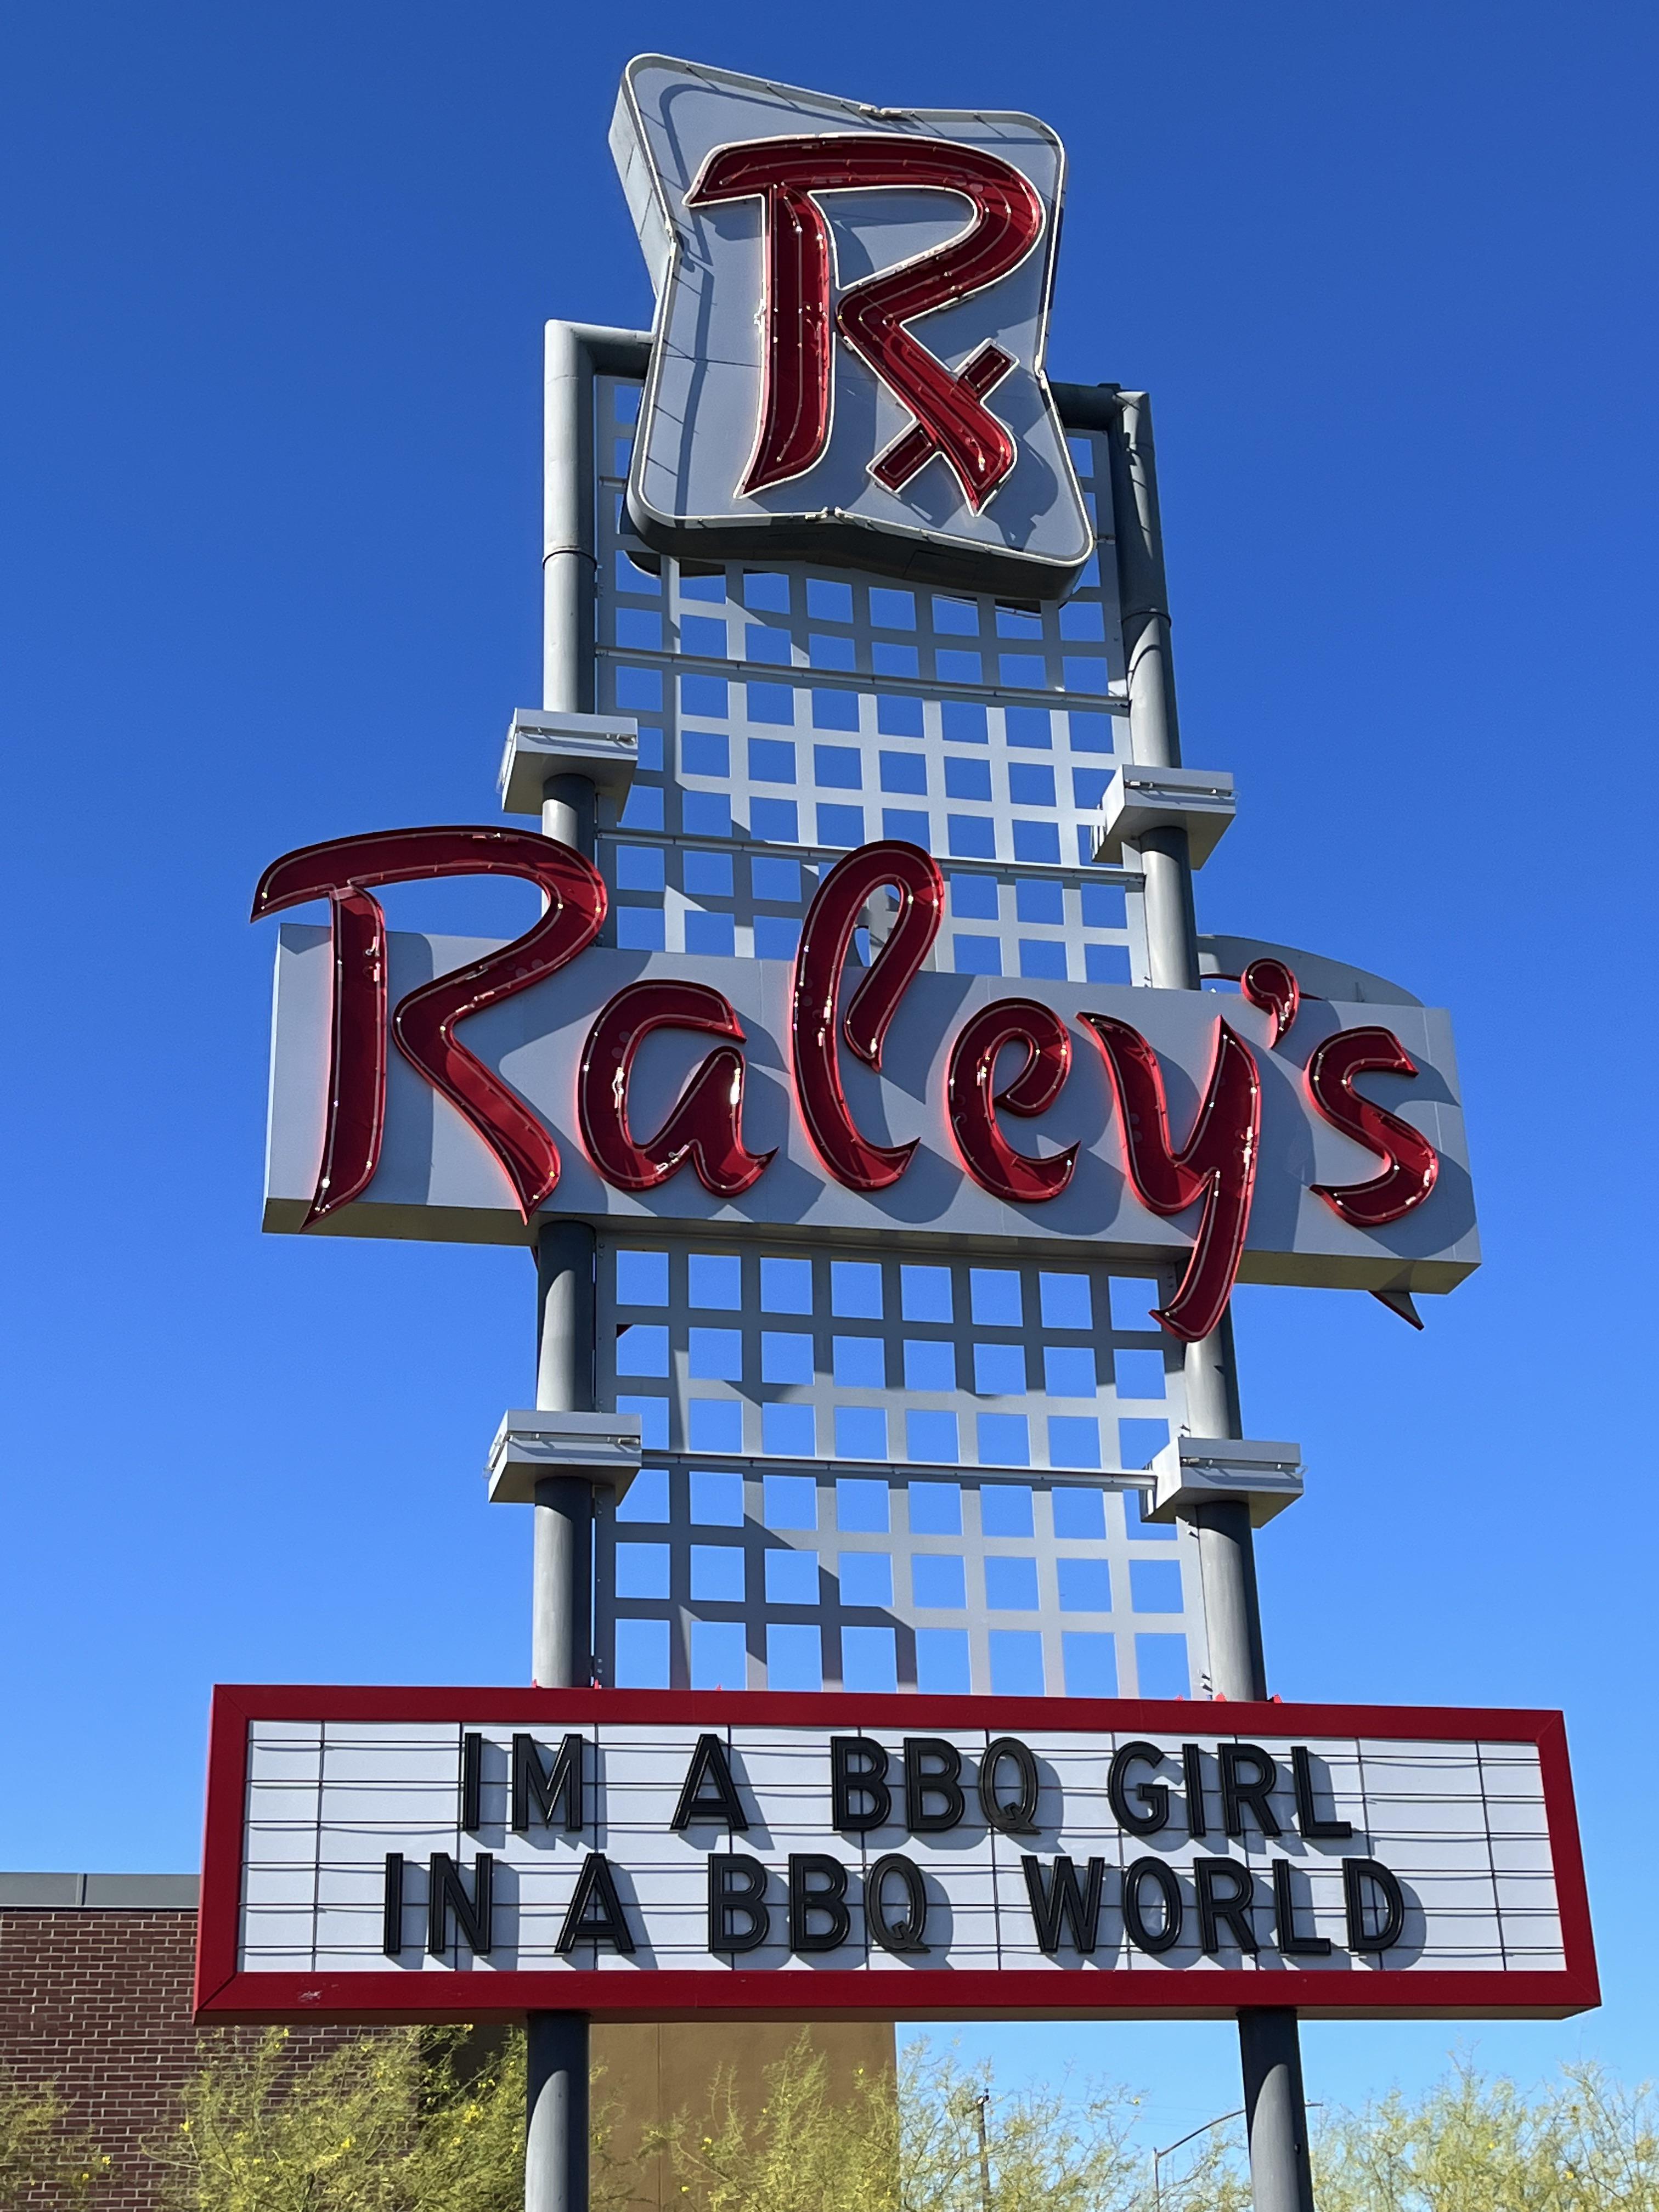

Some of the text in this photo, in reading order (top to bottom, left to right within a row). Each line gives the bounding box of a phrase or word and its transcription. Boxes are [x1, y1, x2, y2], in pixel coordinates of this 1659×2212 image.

[251, 825, 1440, 1343] Raley's
[462, 1732, 1353, 1839] IM A BBQ GIRL
[383, 1852, 1406, 1957] IN A BBQ WORLD
